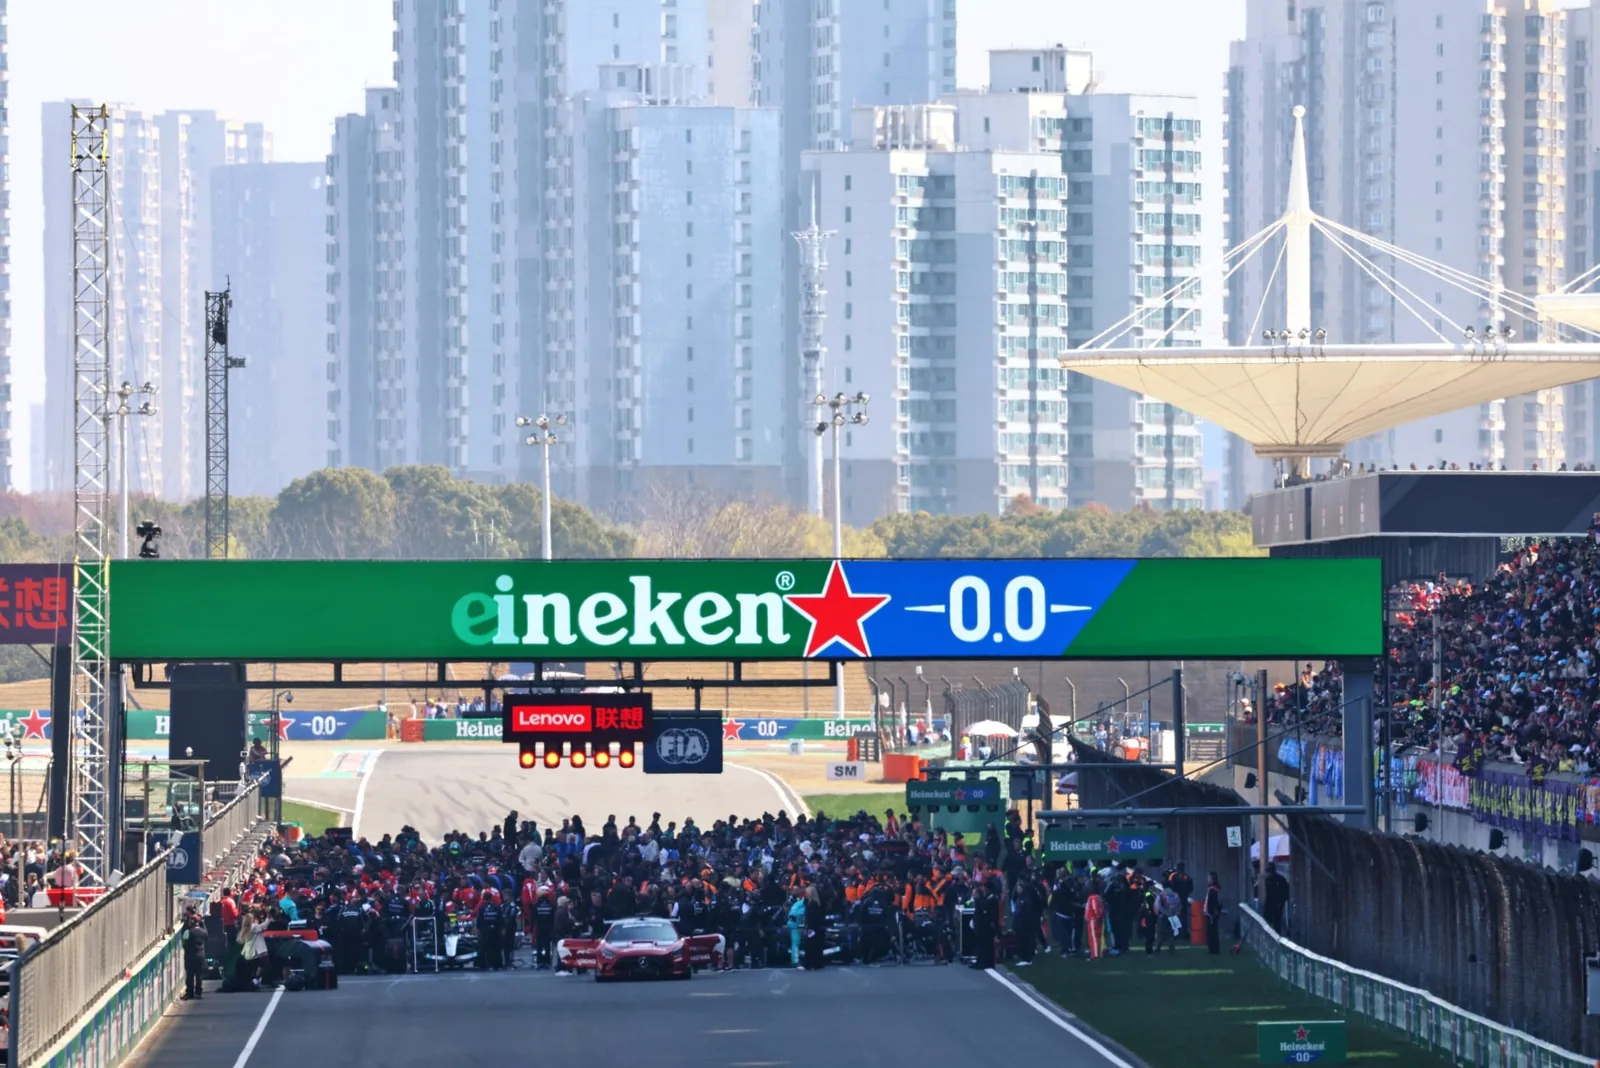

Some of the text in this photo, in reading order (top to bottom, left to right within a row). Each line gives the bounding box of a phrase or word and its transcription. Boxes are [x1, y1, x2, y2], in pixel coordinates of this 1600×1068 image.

[0, 577, 68, 630] 想
[949, 574, 1047, 643] 0.0
[519, 711, 586, 726] Lenovo
[595, 707, 643, 730] 联想
[834, 765, 858, 777] SM
[910, 790, 951, 799] Heineken
[1050, 841, 1101, 851] Heineken
[1279, 1042, 1325, 1052] Heineken
